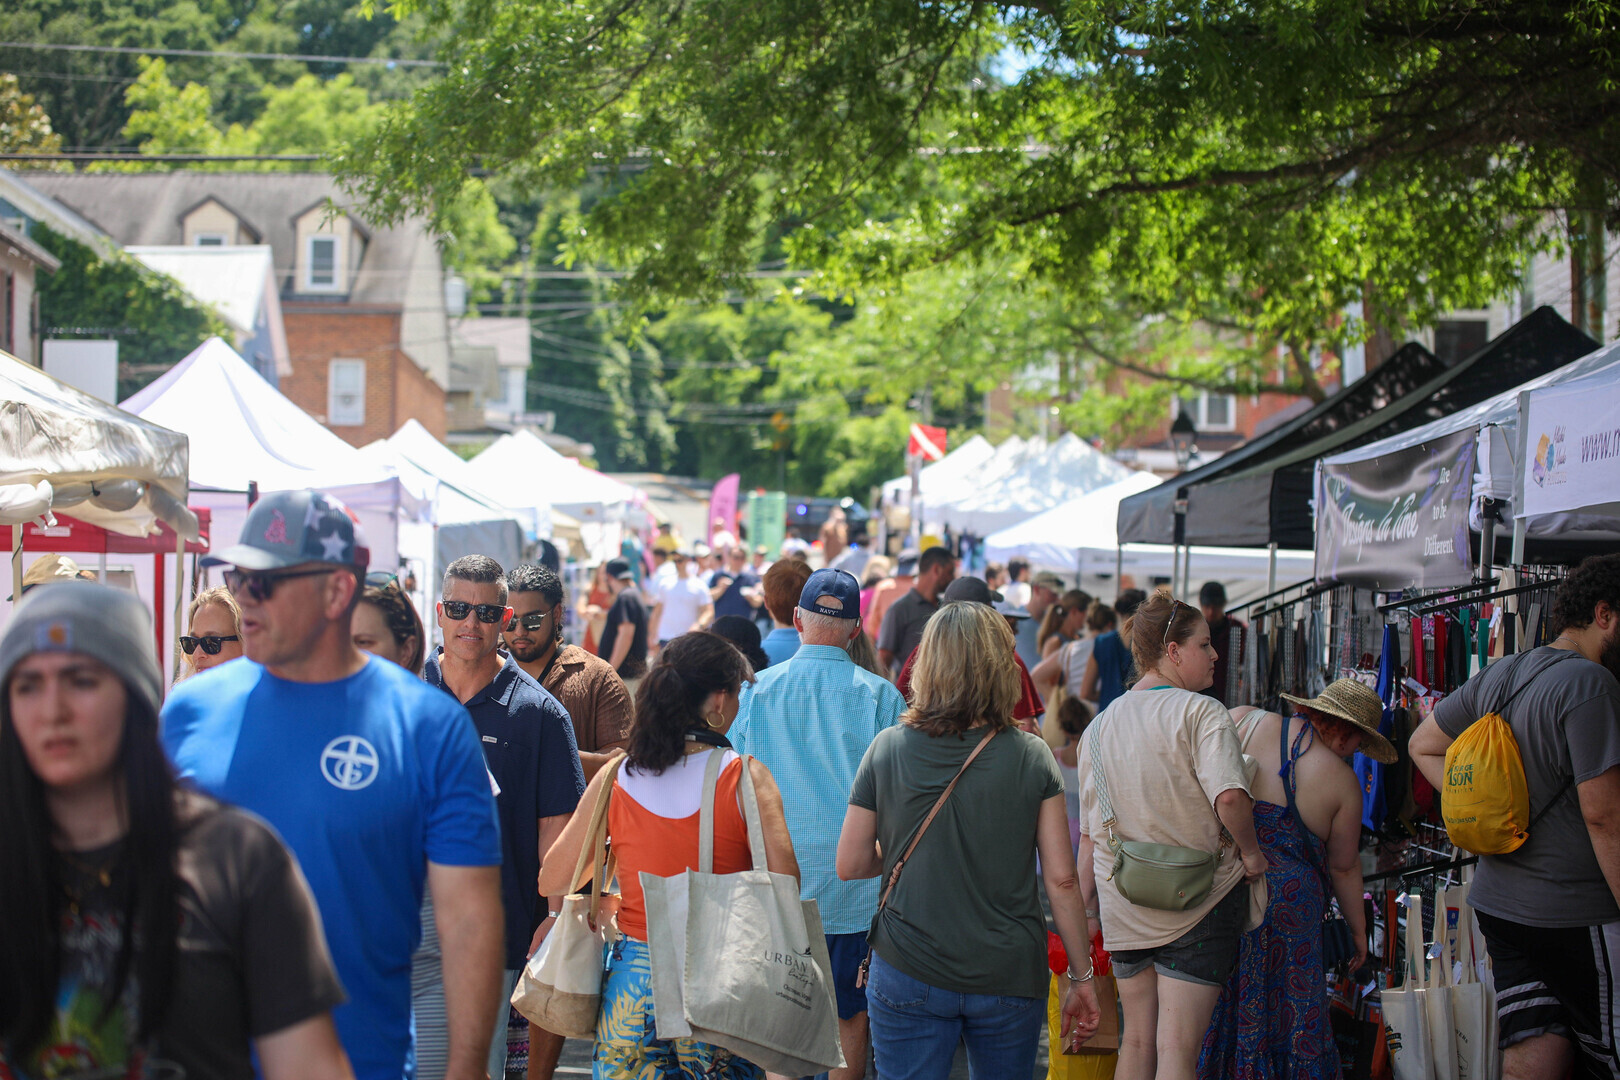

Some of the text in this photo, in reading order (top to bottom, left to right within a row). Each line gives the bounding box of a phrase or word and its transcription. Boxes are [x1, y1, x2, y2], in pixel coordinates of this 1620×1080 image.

[1433, 498, 1447, 520] to be
[1342, 492, 1419, 562] Designs In Time
[1424, 534, 1454, 556] Different
[819, 607, 837, 616] NAVY
[764, 949, 808, 973] URBAN
